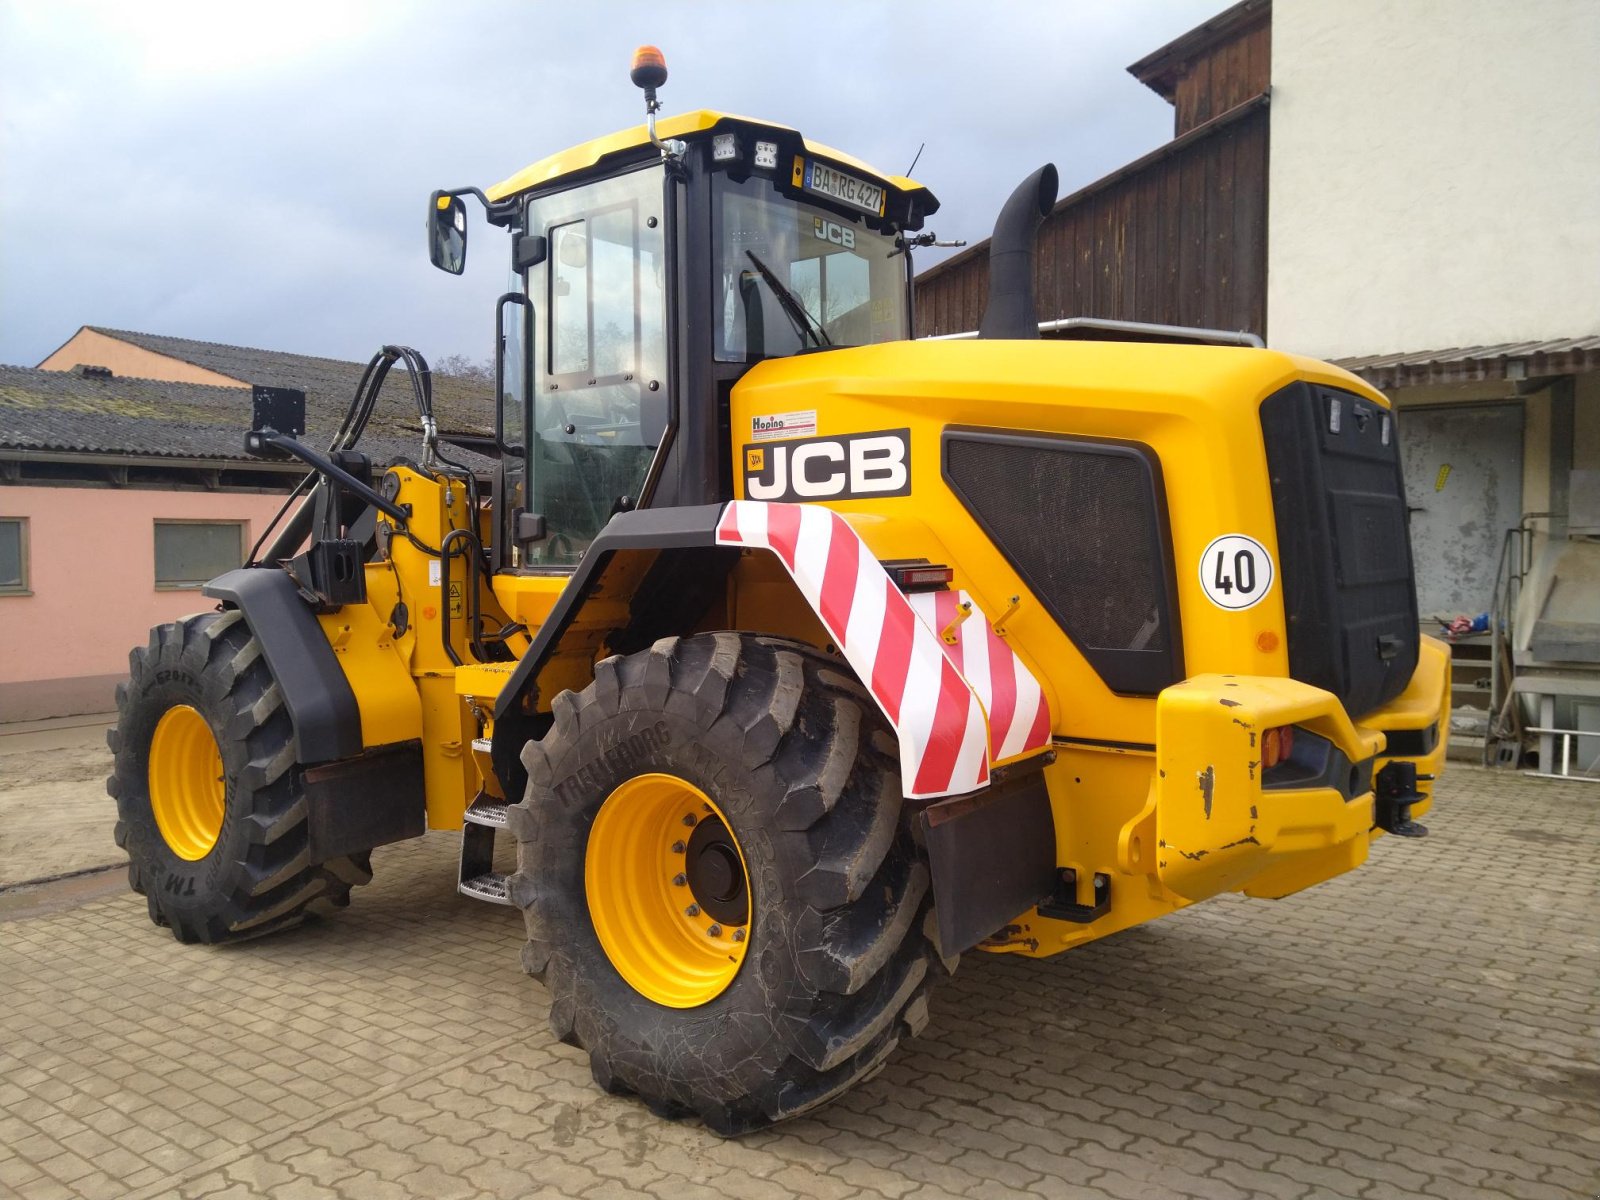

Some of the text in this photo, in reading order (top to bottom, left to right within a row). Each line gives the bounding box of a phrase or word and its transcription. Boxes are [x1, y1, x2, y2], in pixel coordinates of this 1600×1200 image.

[813, 166, 830, 191] BA
[838, 176, 855, 200] RG
[857, 183, 880, 209] 427
[815, 219, 855, 249] JCB
[752, 416, 784, 430] Hoping
[748, 436, 907, 499] JCB
[1215, 550, 1256, 595] 40
[165, 873, 196, 897] TM
